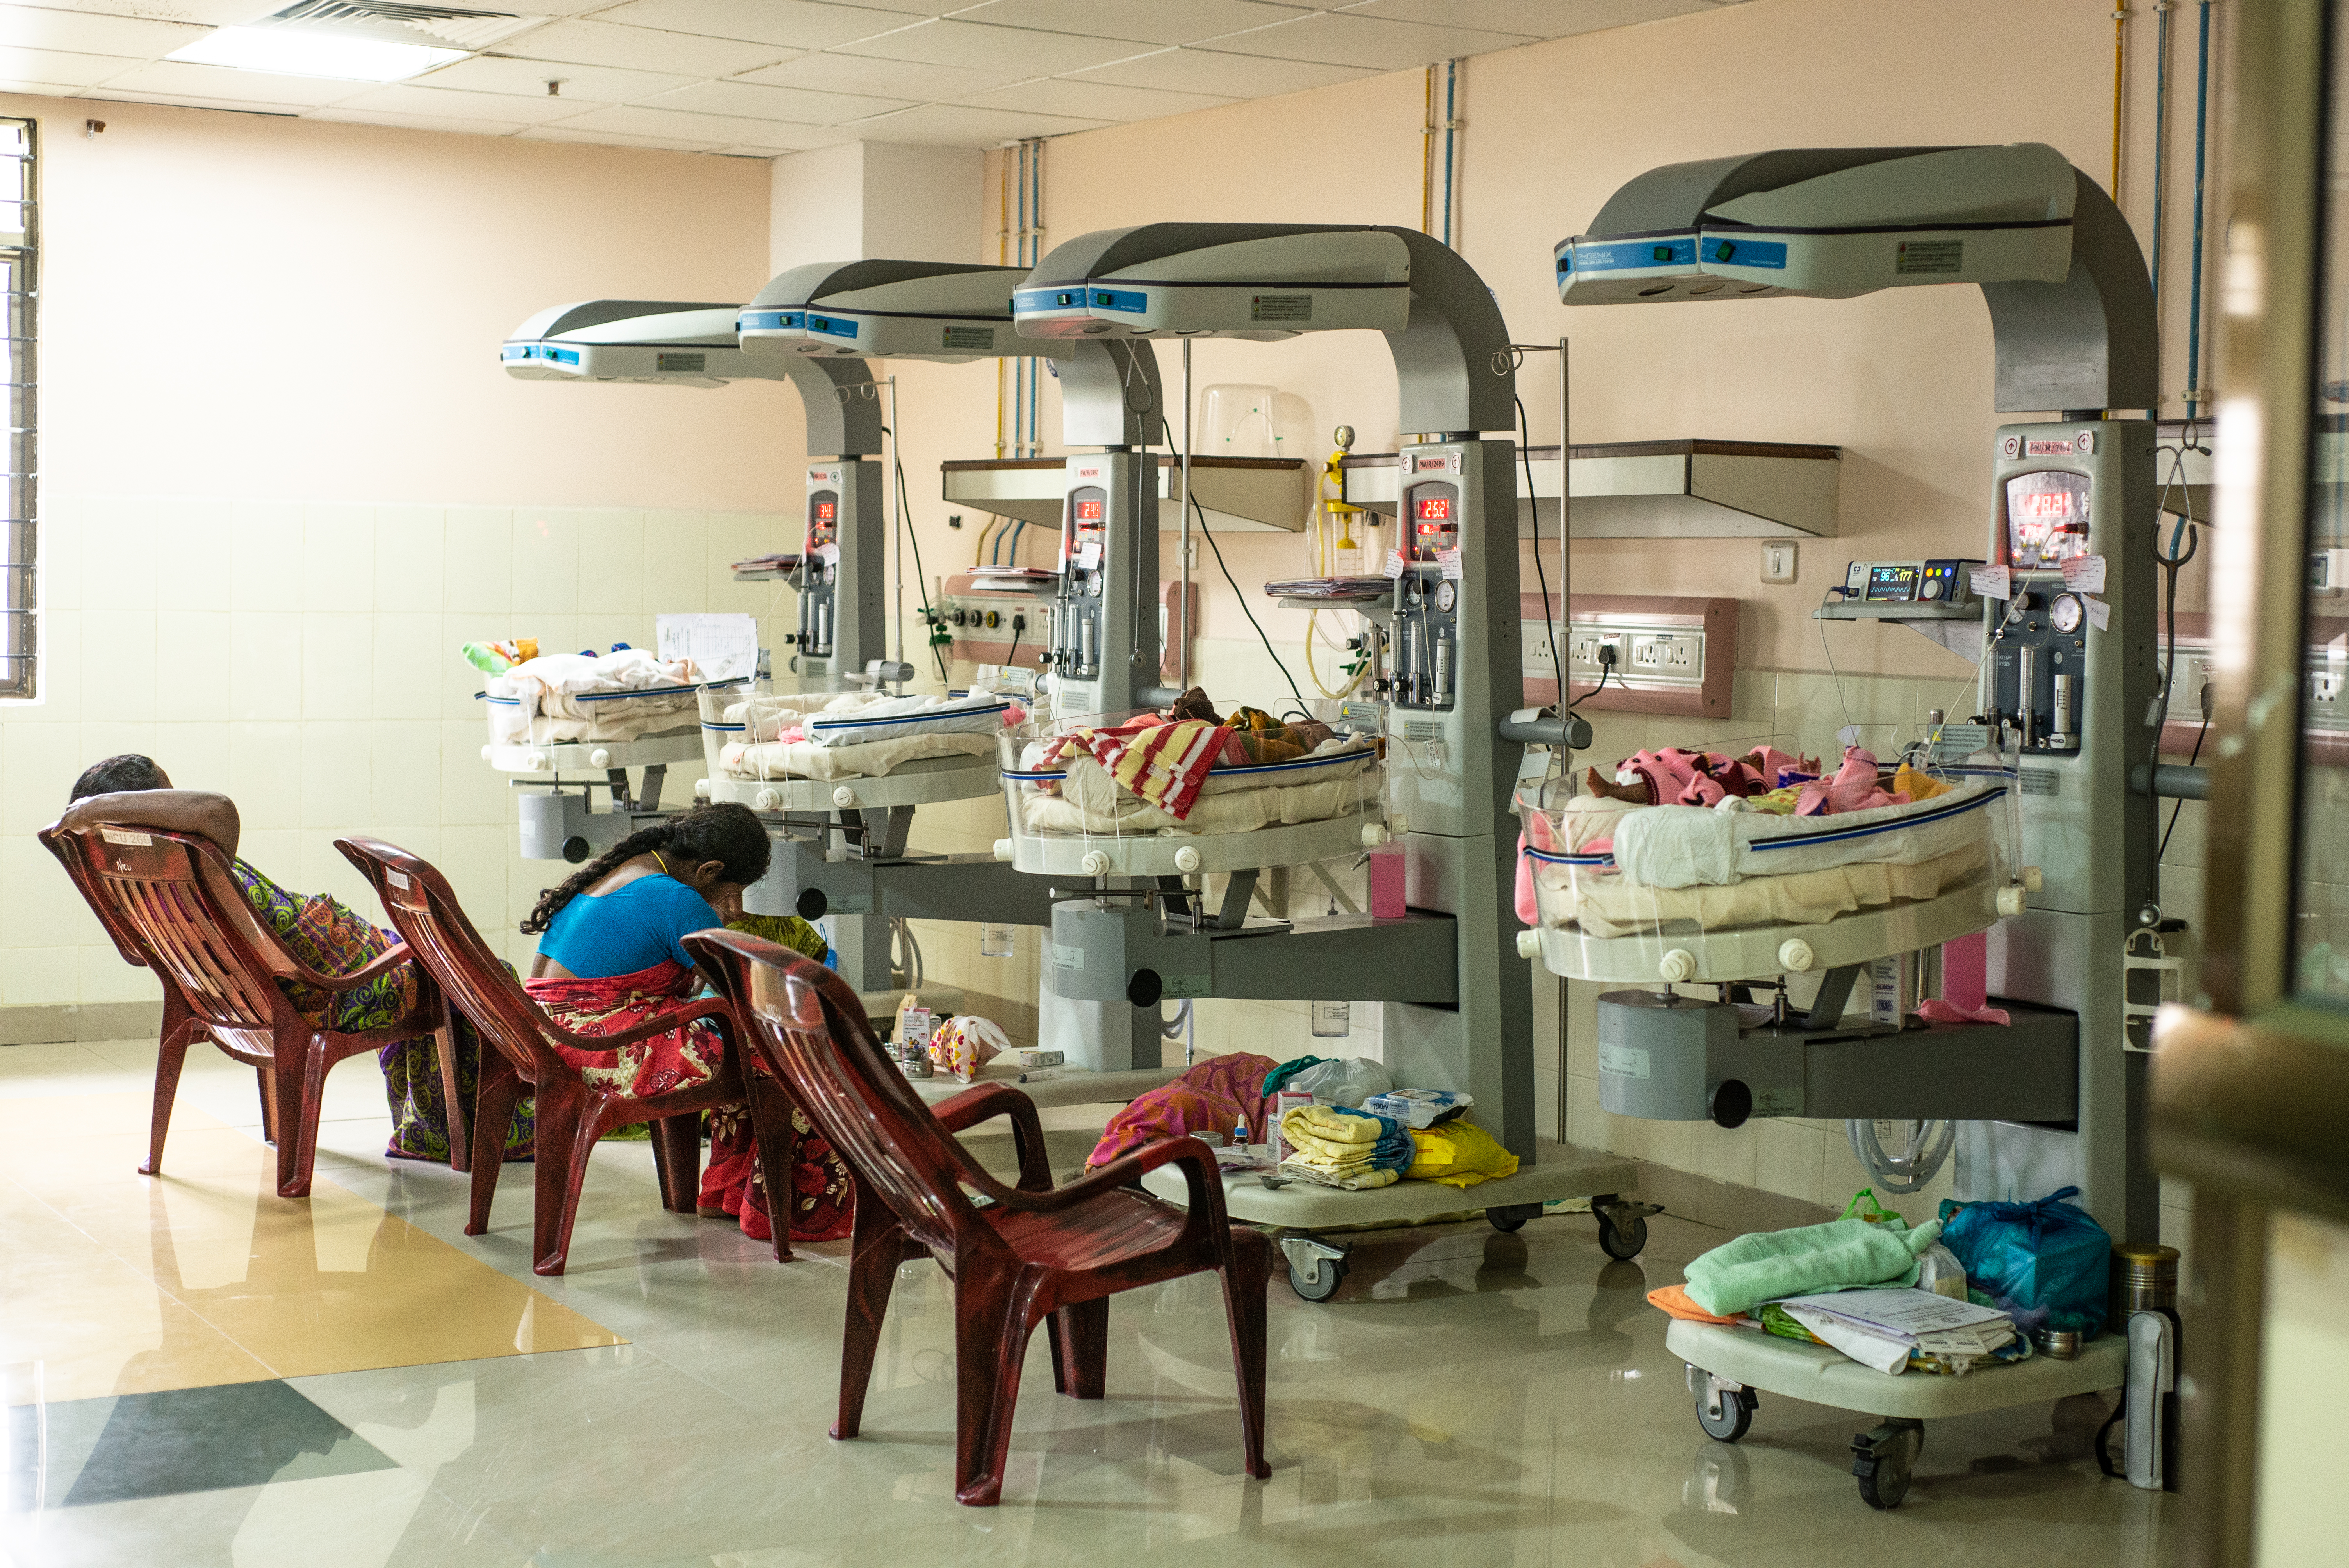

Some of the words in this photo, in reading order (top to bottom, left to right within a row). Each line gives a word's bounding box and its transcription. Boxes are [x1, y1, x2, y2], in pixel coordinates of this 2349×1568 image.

[1419, 460, 1444, 469] PW/R/2499
[1880, 572, 1890, 581] 96
[1899, 571, 1913, 581] 177
[104, 832, 127, 843] NICU
[130, 834, 150, 844] 266
